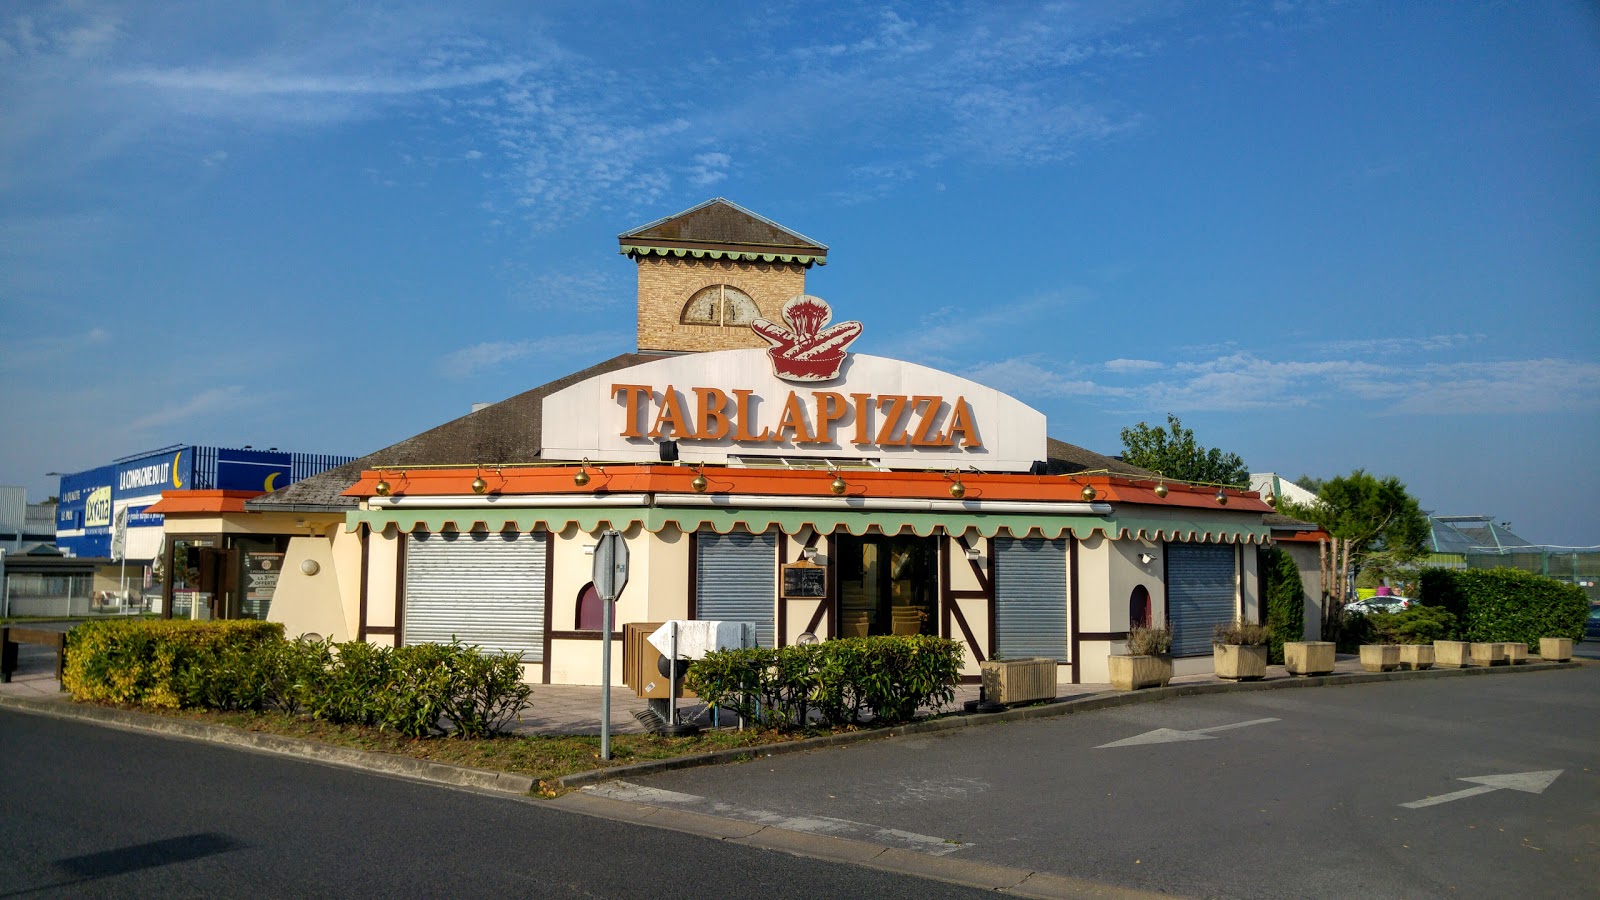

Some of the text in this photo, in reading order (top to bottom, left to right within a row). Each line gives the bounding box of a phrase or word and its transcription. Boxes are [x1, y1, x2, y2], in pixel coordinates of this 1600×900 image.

[611, 384, 983, 447] TABLAPIZZA
[120, 462, 169, 490] LA COMPAGNIE DU LIT
